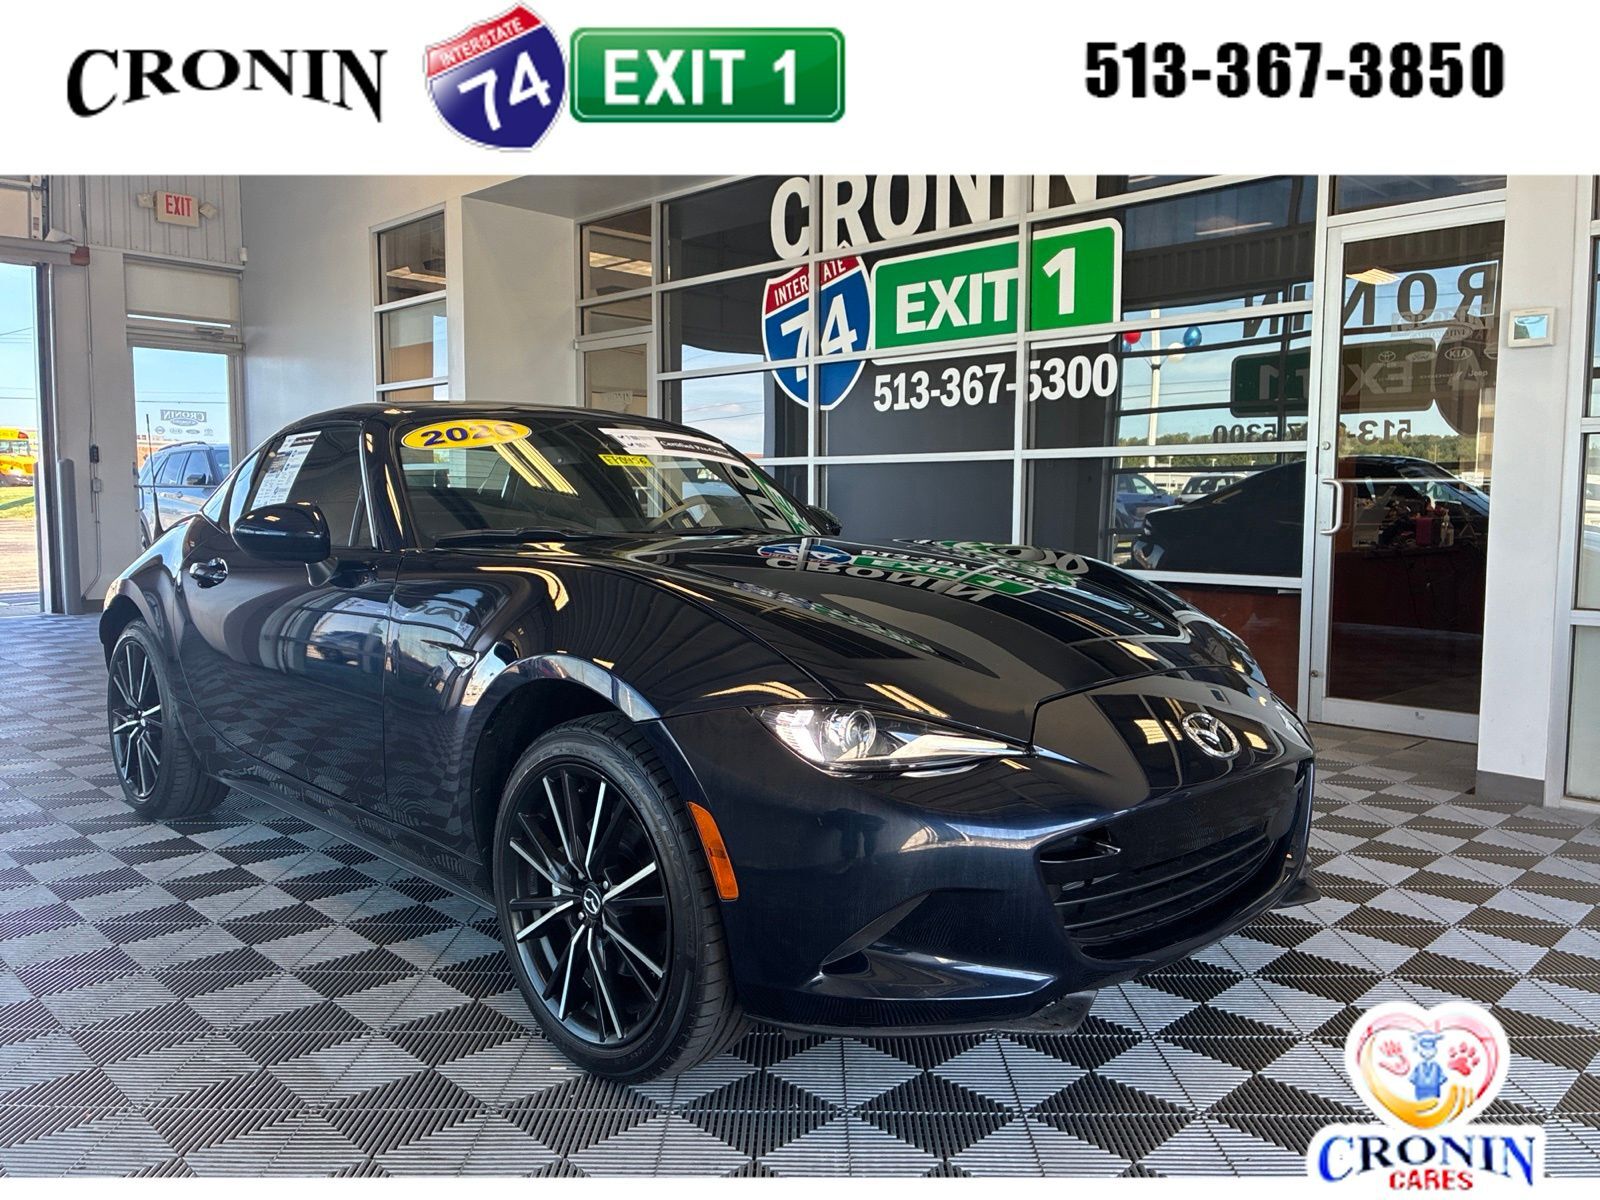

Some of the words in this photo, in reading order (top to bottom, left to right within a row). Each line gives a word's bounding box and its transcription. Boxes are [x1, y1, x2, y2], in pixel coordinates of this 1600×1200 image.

[165, 194, 192, 216] EXIT
[774, 259, 846, 307] INTERATE
[896, 268, 1019, 335] EXIT
[1042, 247, 1076, 316] 1
[780, 294, 858, 382] 74
[1449, 348, 1468, 358] KIA
[873, 353, 1118, 413] 513-367-5300
